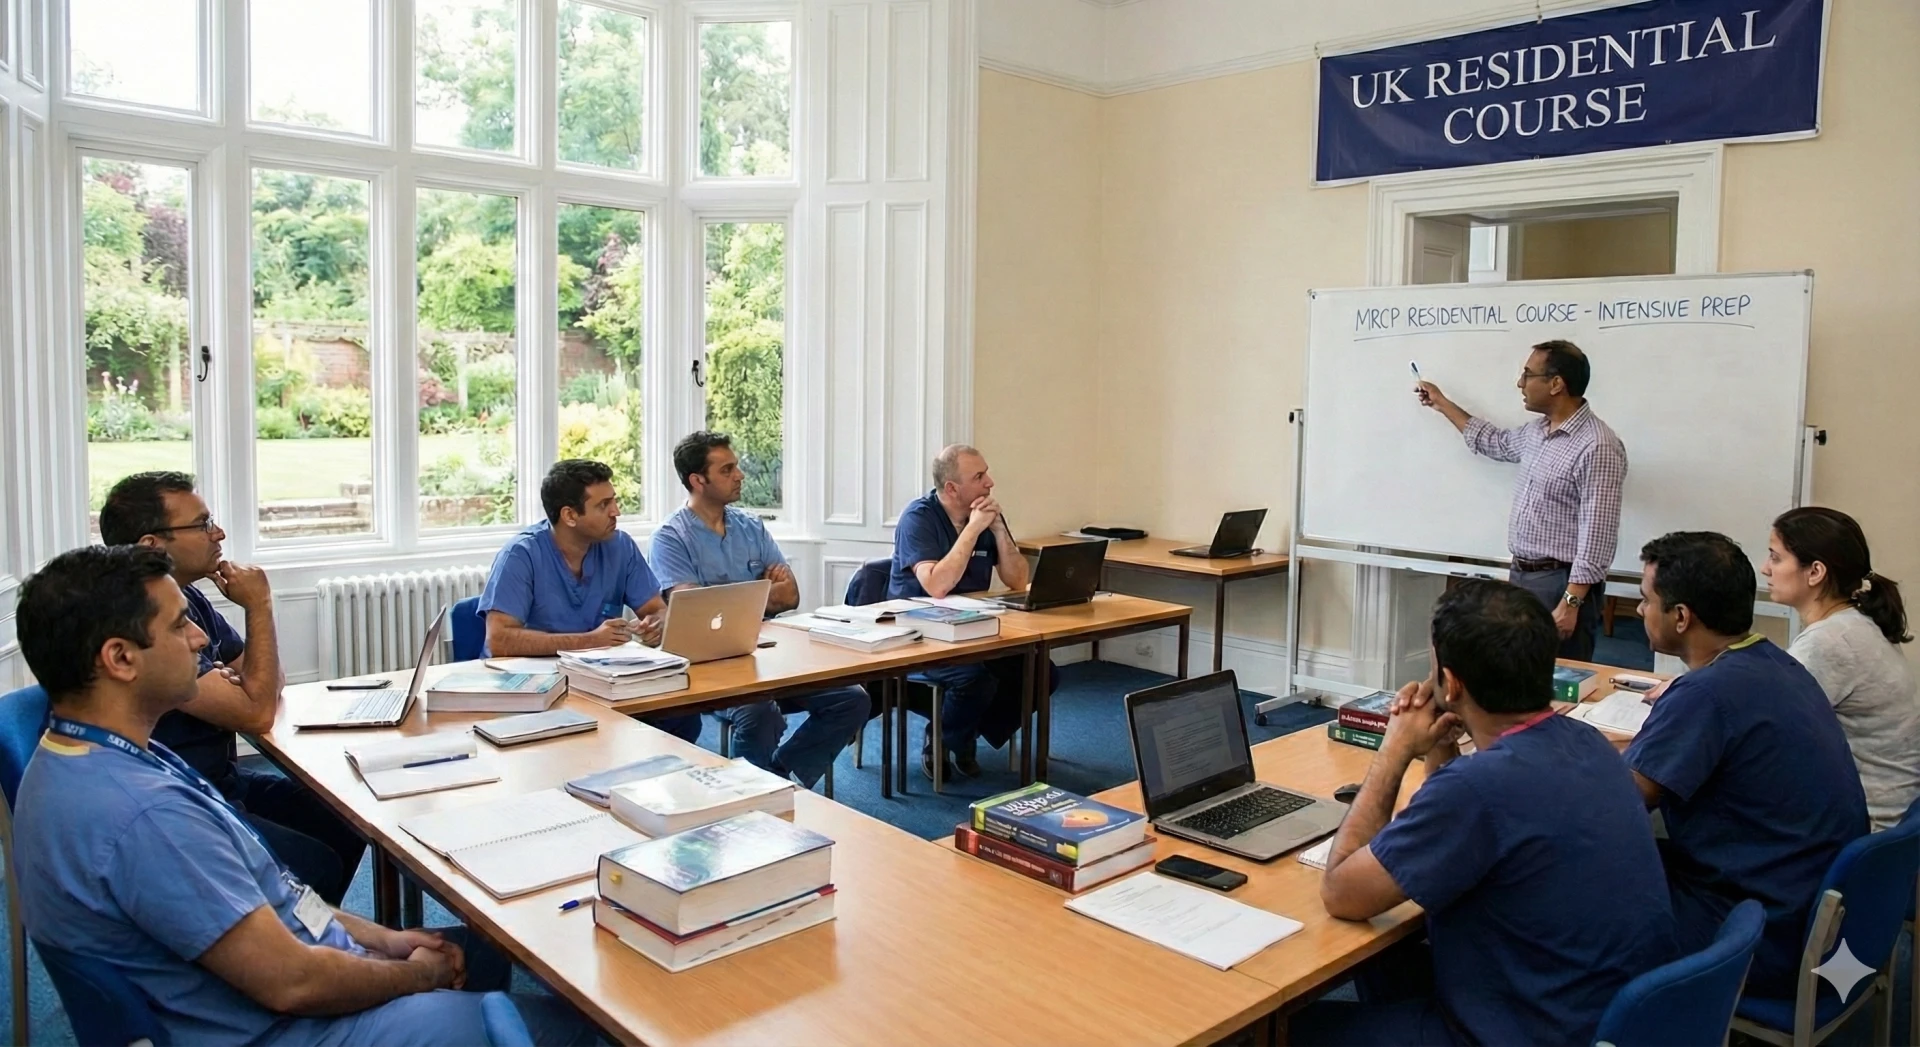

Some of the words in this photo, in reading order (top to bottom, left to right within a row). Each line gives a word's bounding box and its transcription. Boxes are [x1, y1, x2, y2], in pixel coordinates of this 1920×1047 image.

[1350, 67, 1414, 109] UK
[1424, 10, 1776, 99] RESIDENTIAL
[1443, 82, 1647, 145] COURSE
[1355, 306, 1401, 332] MRCP
[1407, 304, 1508, 328] RESIDENTIAL
[1516, 302, 1579, 324] COURSE
[1598, 299, 1691, 322] INTENSIVE
[1701, 294, 1751, 318] PREP
